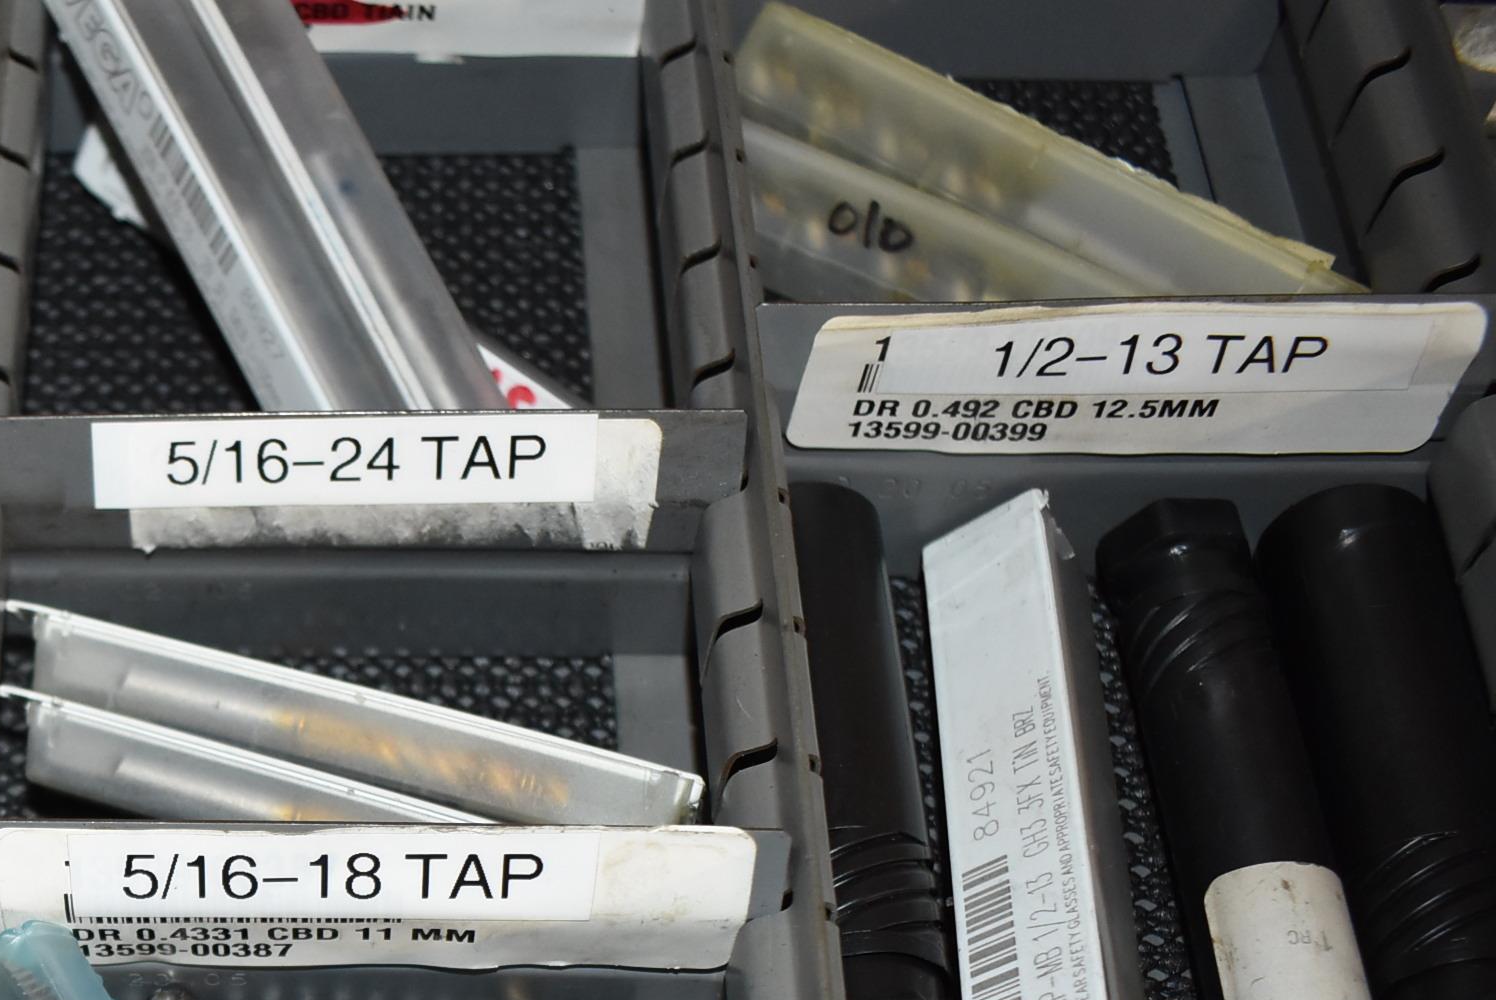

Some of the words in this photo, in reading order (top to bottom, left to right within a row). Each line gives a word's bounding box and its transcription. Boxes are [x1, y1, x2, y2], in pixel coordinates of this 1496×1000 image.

[994, 335, 1183, 379] 1/2-13
[1205, 336, 1330, 375] TAP
[854, 400, 900, 417] DR
[911, 400, 999, 419] 0.492
[1012, 400, 1078, 418] CBD
[1092, 399, 1219, 418] 12.5MM
[846, 421, 1047, 442] 13599-00399
[166, 437, 401, 486] 5/16-24
[421, 435, 547, 481] TAP
[1010, 703, 1037, 737] BRZ
[1044, 734, 1062, 772] SAFETY
[963, 747, 1001, 841] 84921
[1013, 774, 1045, 814] 3FX
[1048, 772, 1071, 851] APPROPRIATE
[1018, 817, 1051, 858] GH3
[122, 853, 384, 902] 5/16-18
[406, 853, 545, 900] TAP
[1021, 870, 1067, 942] 1/2-13
[1061, 876, 1081, 929] GLASSES
[74, 928, 121, 943] DR
[137, 927, 250, 943] 0.4331
[268, 927, 340, 942] CBD
[355, 927, 393, 942] 11
[412, 927, 477, 943] MM
[1066, 929, 1086, 974] SAFETY
